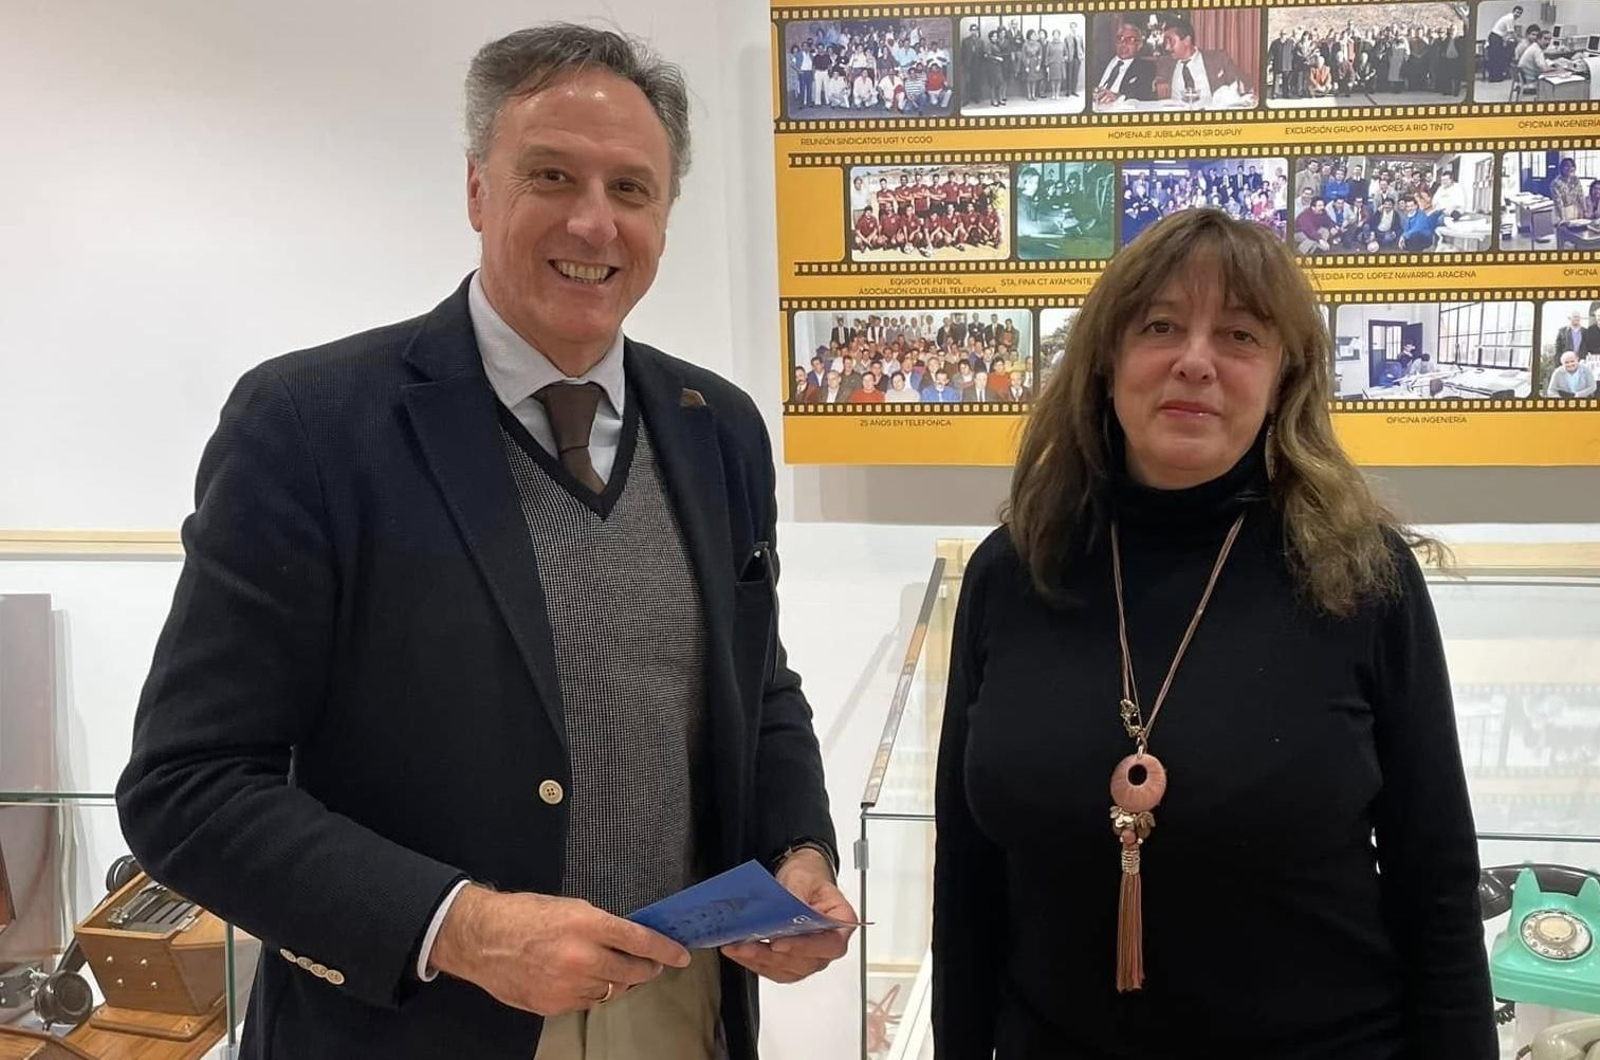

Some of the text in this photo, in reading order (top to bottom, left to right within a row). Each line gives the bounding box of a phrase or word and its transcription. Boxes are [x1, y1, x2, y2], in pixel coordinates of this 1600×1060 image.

[1285, 126, 1332, 135] EXCURSIÓN
[1333, 125, 1364, 134] GRUPO
[1365, 124, 1403, 133] MAYORES
[1405, 123, 1412, 131] A
[1429, 122, 1454, 132] TINTO
[1108, 131, 1152, 139] HOMENAJE
[1154, 128, 1200, 138] JUBILACIÓN
[836, 136, 881, 145] SINDICATOS
[900, 136, 906, 144] Y
[907, 136, 933, 144] CCOO
[1436, 269, 1477, 278] ARACENA
[1563, 268, 1598, 277] OFICINA
[890, 278, 920, 286] EQUIPO
[921, 278, 931, 286] DE
[909, 287, 947, 295] CULTURAL
[893, 419, 904, 427] EN
[1386, 415, 1420, 424] OFICINA
